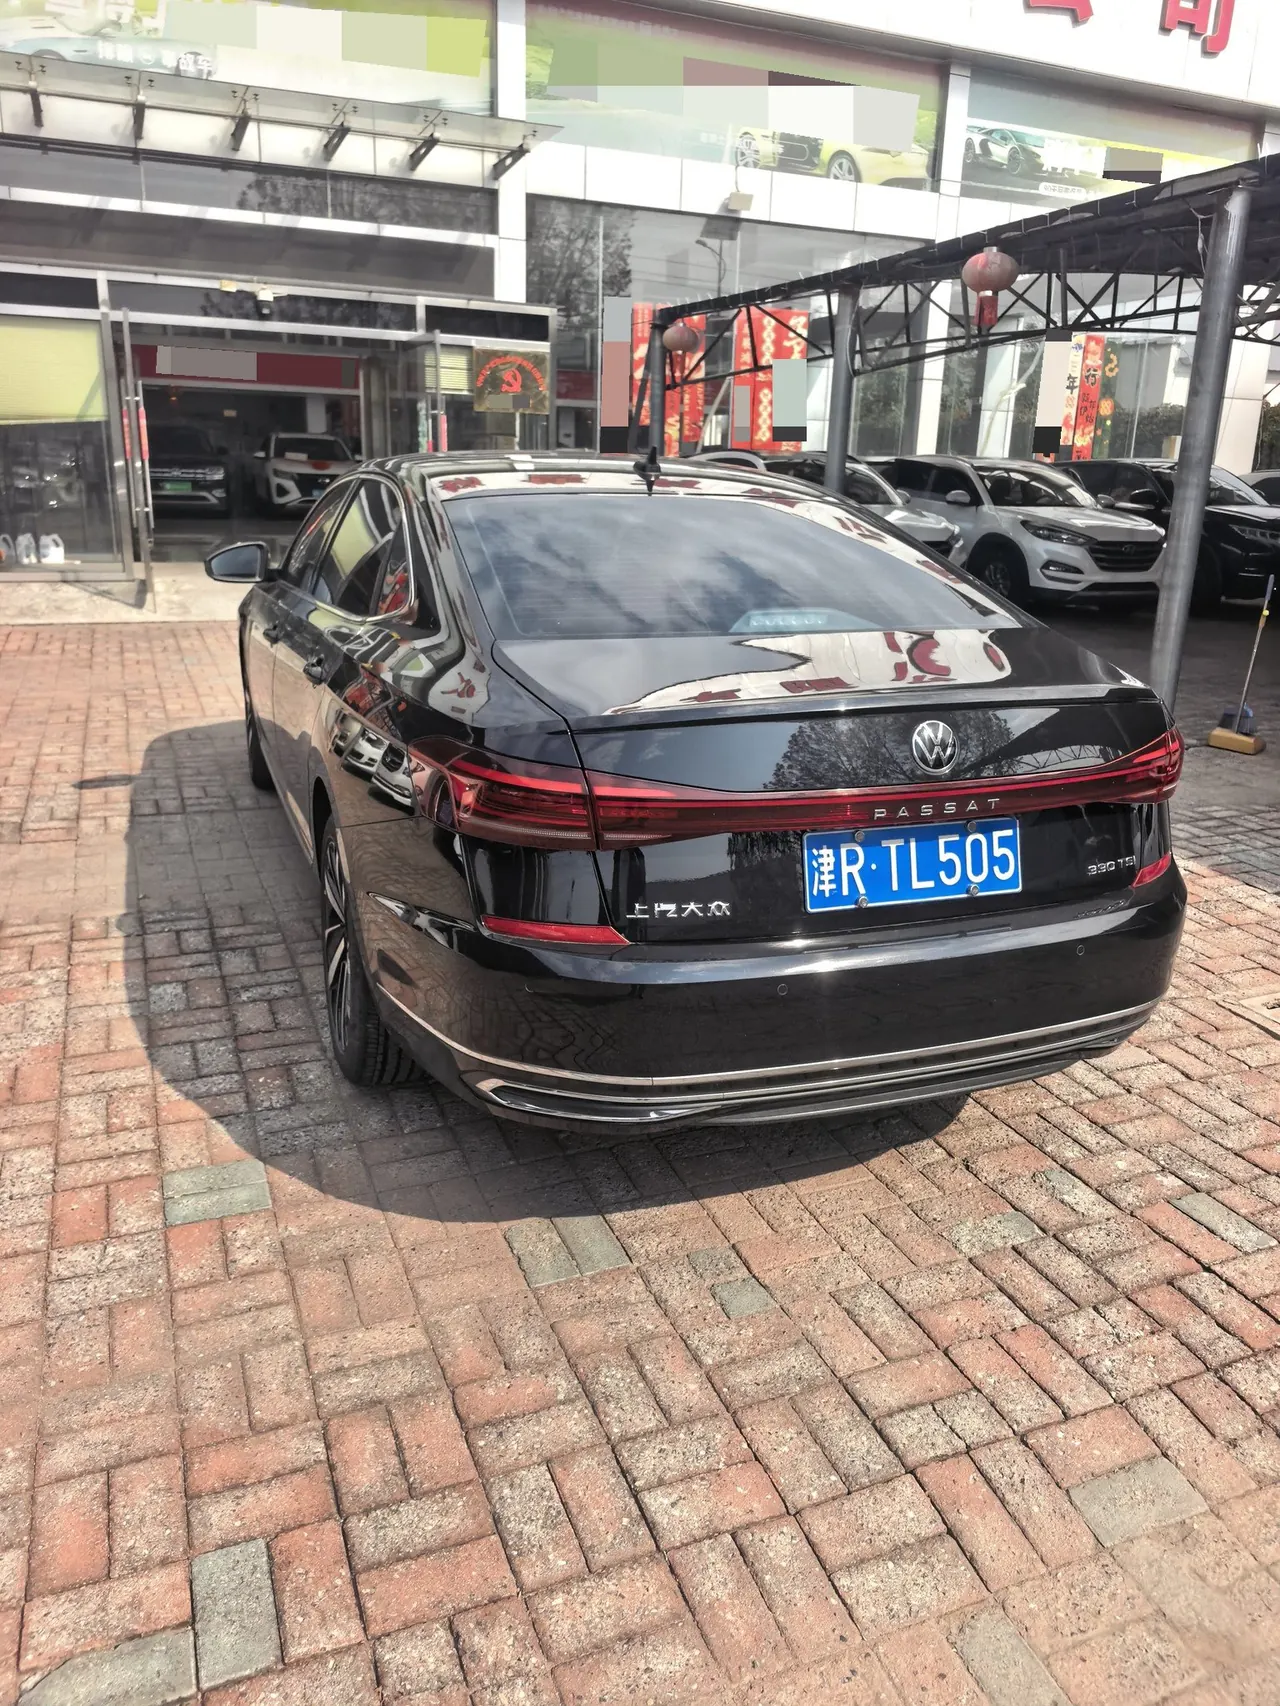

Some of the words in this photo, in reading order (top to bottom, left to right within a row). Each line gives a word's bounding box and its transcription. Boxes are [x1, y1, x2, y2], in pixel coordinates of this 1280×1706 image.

[873, 798, 1000, 821] PASSAT
[626, 901, 731, 919] 上汽大众
